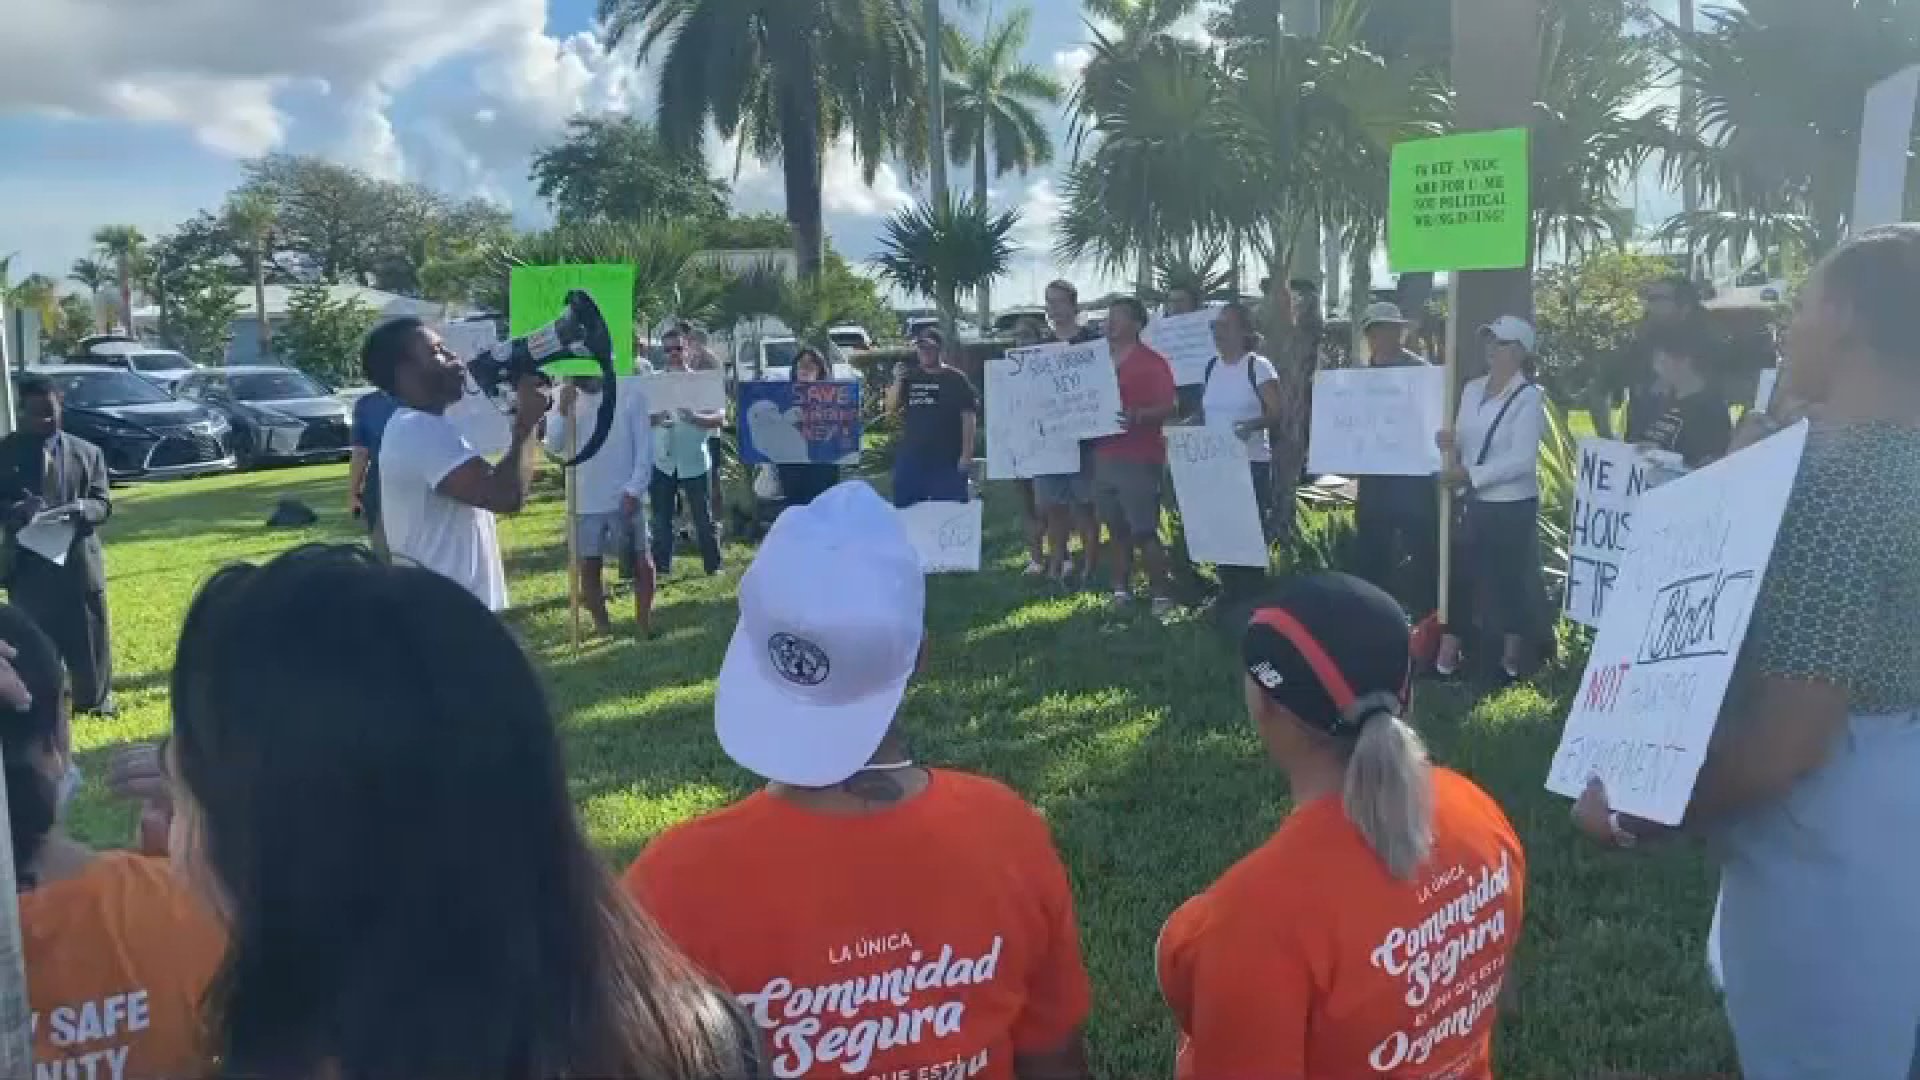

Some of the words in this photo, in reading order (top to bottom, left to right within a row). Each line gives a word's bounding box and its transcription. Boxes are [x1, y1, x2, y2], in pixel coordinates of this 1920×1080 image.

[1439, 191, 1506, 209] POLITICAL
[1440, 178, 1465, 193] FOR
[1582, 658, 1631, 713] NOT
[1369, 848, 1512, 977] Comunidad
[1416, 884, 1432, 904] LA
[828, 944, 851, 965] LA
[855, 929, 913, 960] ÚNICA
[1405, 908, 1505, 1007] Segura
[734, 934, 1004, 1030] Comunidad
[50, 989, 150, 1047] SAFE
[771, 1000, 966, 1079] Segura
